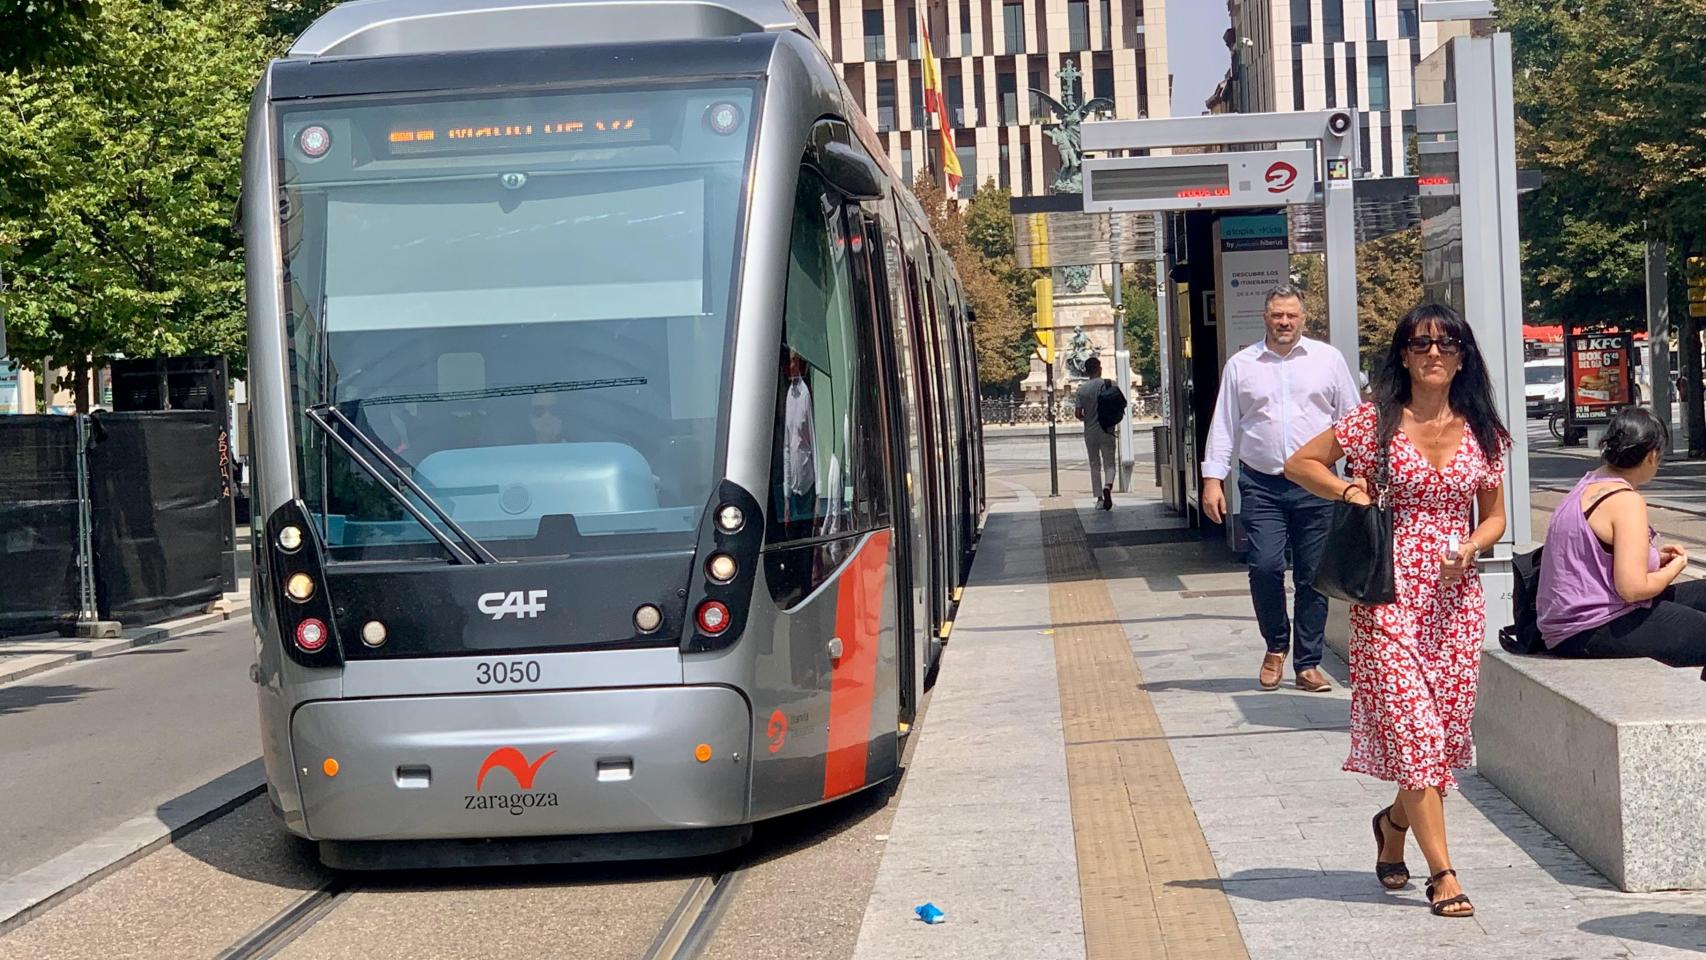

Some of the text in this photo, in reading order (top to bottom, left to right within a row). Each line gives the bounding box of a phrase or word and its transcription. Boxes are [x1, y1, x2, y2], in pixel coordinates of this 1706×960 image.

[1226, 241, 1234, 249] by
[1240, 278, 1279, 286] ITINERARIOS
[1589, 338, 1622, 350] KFC
[1578, 351, 1602, 361] BOX
[1578, 361, 1591, 369] DEL
[478, 589, 548, 620] CAF
[476, 660, 541, 684] 3050
[465, 792, 558, 816] zaragoza
